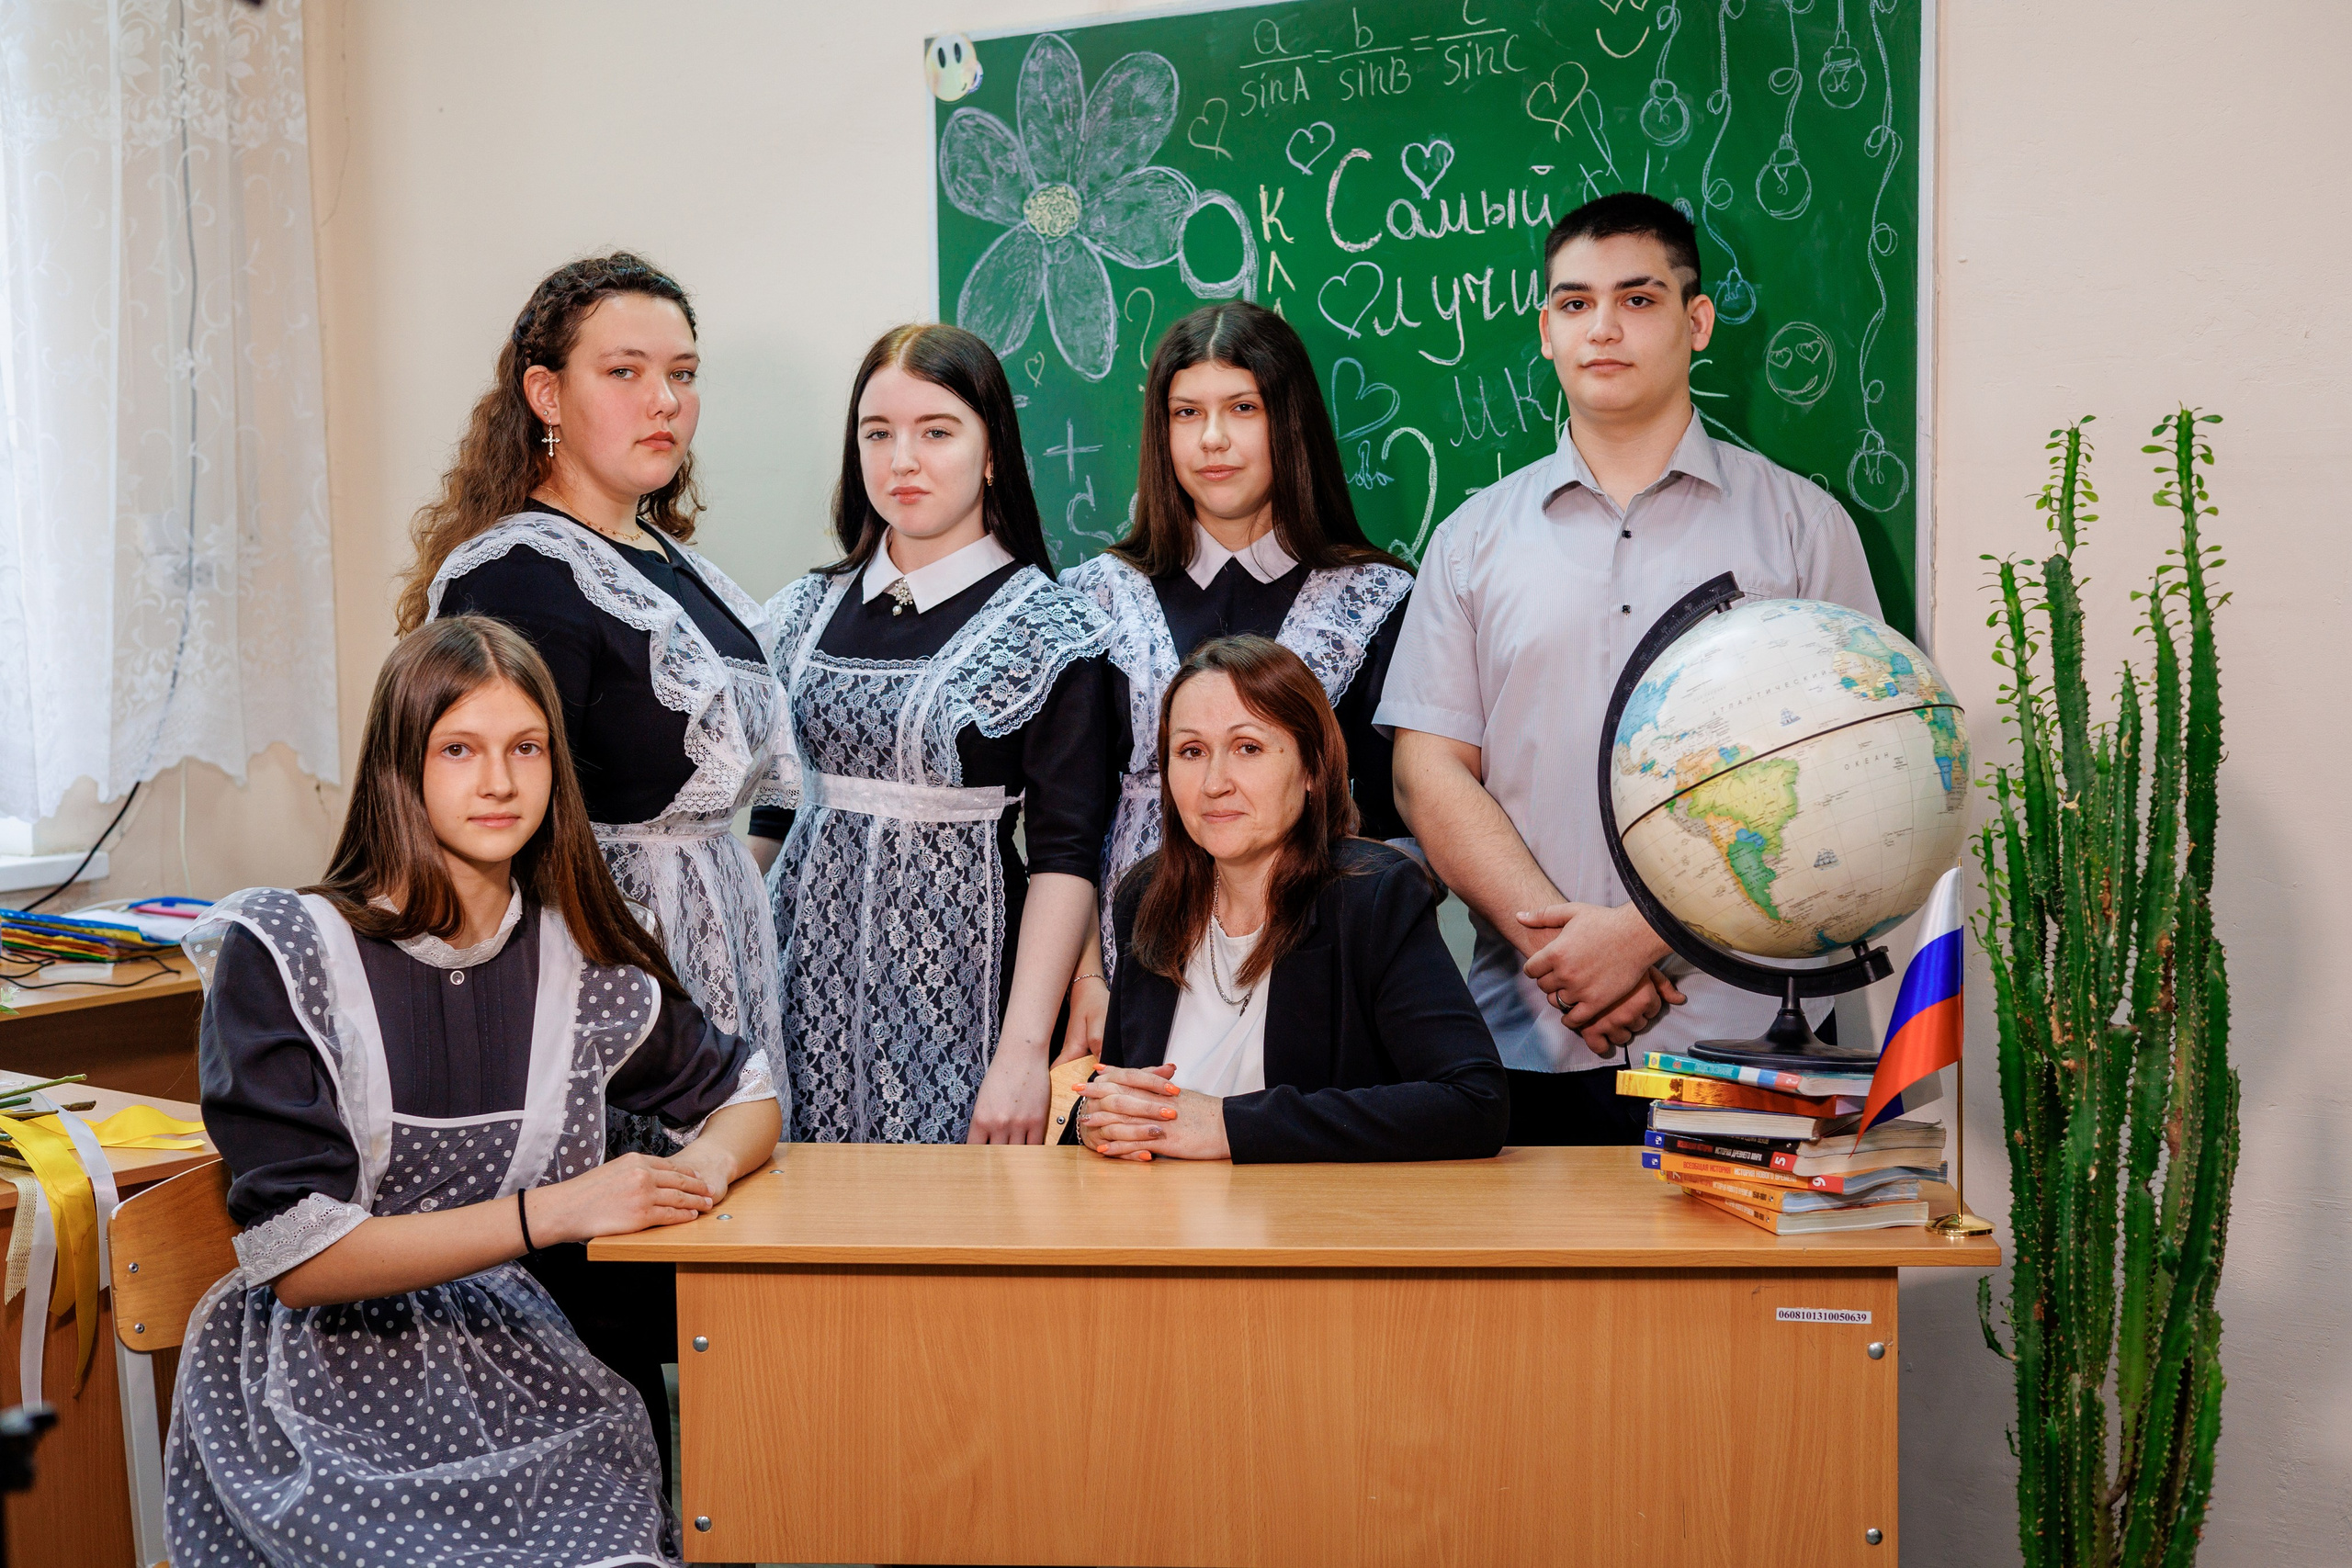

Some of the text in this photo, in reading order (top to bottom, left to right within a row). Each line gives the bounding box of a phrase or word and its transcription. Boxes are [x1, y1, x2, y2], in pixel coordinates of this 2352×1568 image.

[1352, 6, 1374, 49] b
[1325, 147, 1556, 254] Самый
[1844, 752, 1889, 771] ОКЕАН
[1774, 1156, 1787, 1167] 5
[1709, 1164, 1731, 1175] ИСТОРИЯ
[1778, 1310, 1867, 1322] 0608101310050639
